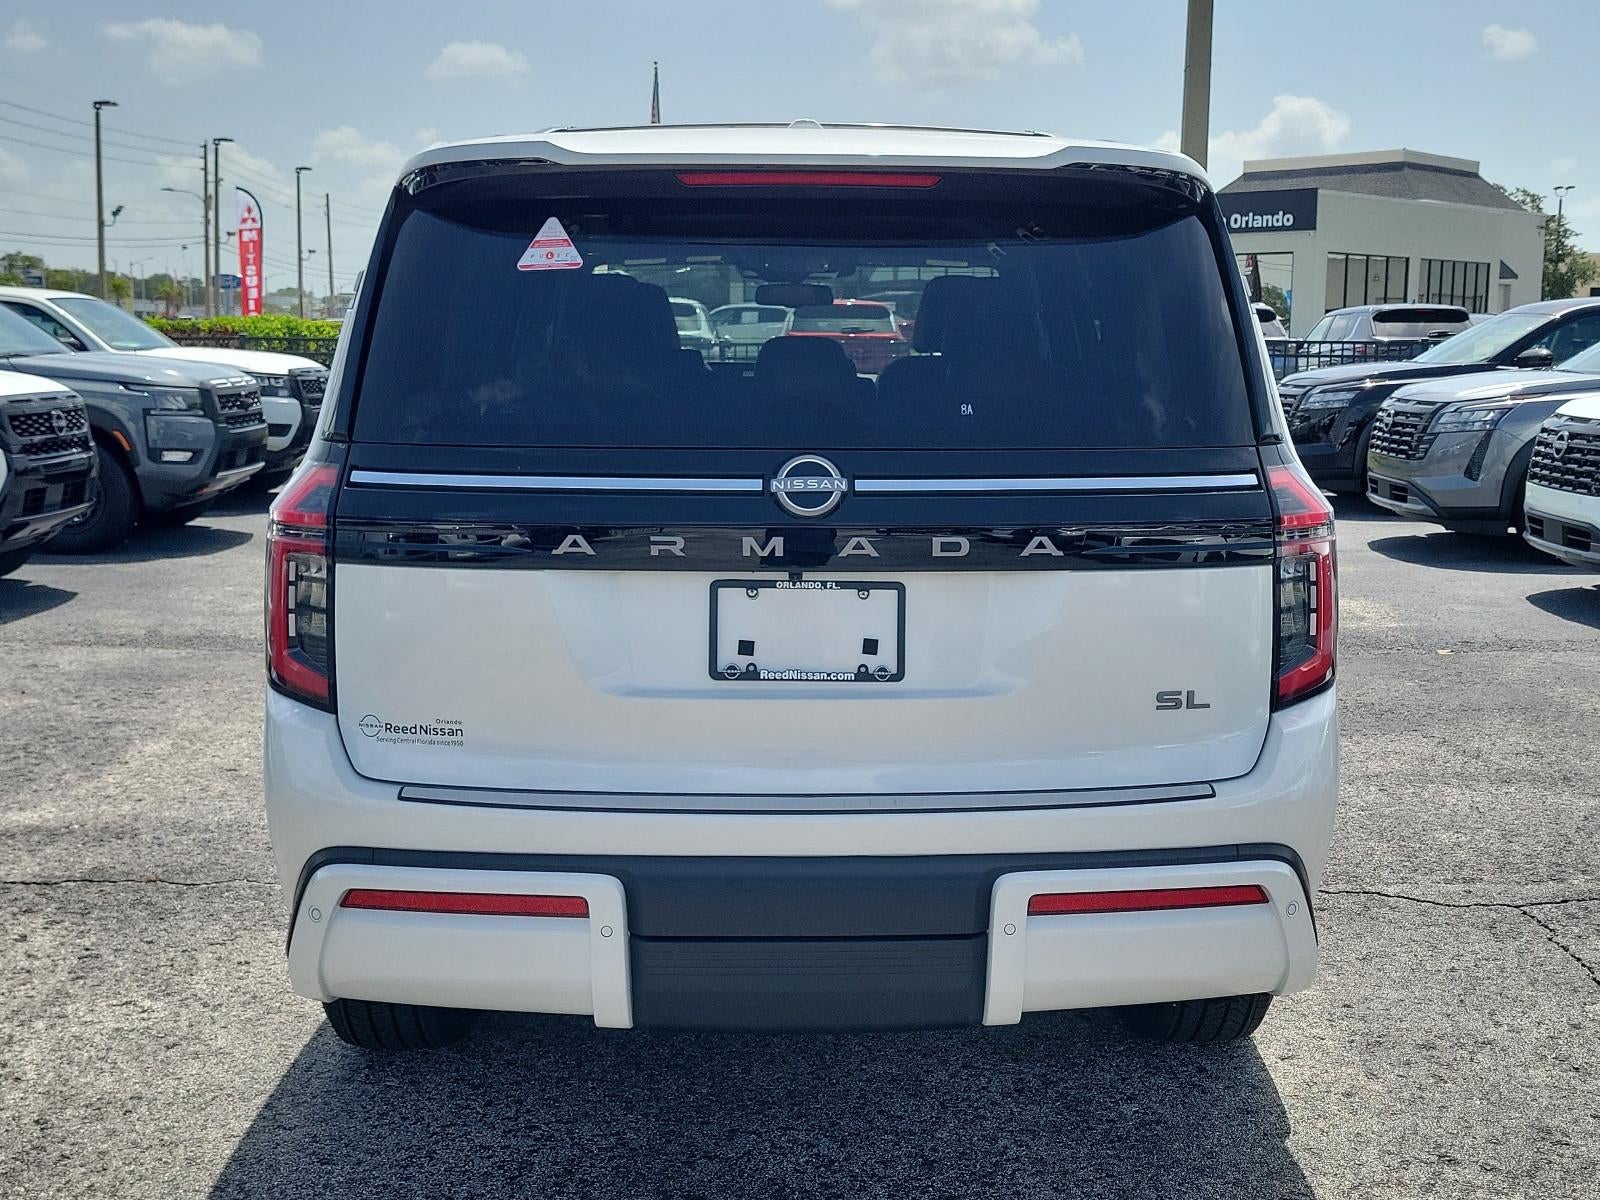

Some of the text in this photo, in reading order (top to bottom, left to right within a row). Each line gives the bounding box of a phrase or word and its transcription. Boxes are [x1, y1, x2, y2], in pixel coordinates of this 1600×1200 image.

[1229, 210, 1294, 229] Orlando
[241, 229, 259, 316] MITSUBI
[960, 403, 973, 415] 8A
[772, 479, 846, 491] NISSAN
[551, 534, 1065, 557] ARMADA
[775, 581, 825, 590] ORLANDO,
[760, 669, 855, 681] ReedNissan.com
[1156, 690, 1211, 710] SL
